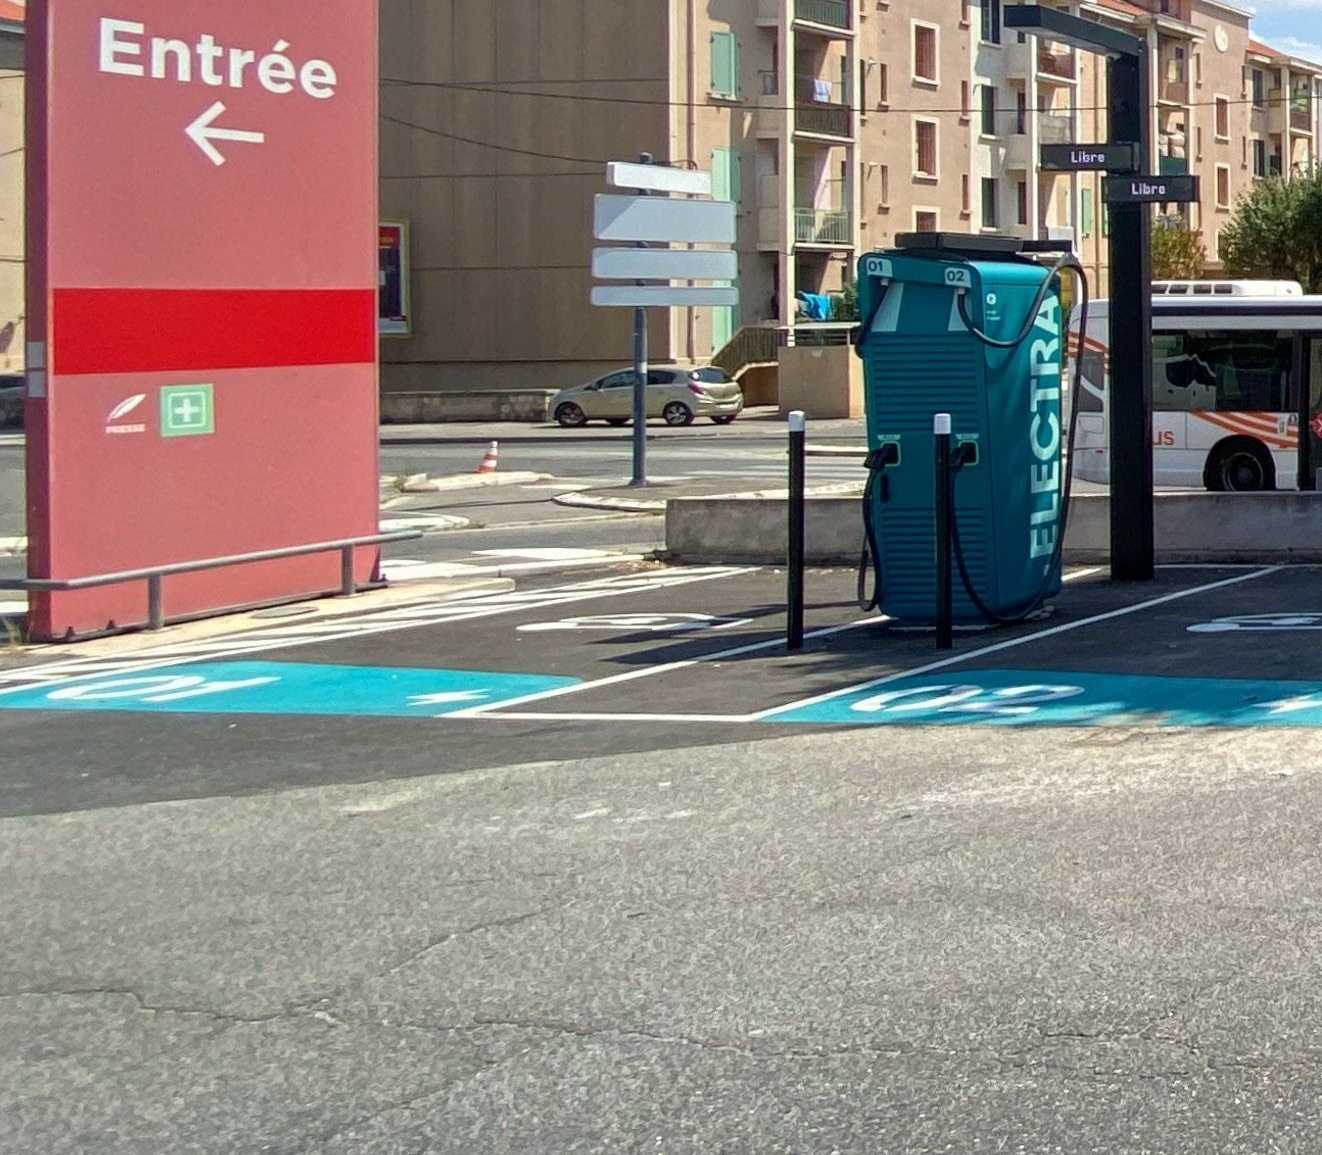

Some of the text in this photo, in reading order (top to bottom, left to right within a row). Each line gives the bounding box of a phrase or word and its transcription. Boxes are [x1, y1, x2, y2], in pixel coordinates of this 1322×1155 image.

[99, 17, 337, 99] Entrée
[1071, 151, 1105, 163] Libre
[1131, 183, 1166, 195] Libre
[868, 260, 883, 272] 01
[946, 270, 965, 282] 02
[1030, 293, 1060, 559] ELECTRA
[47, 675, 281, 702] 01
[850, 684, 1084, 713] 02
